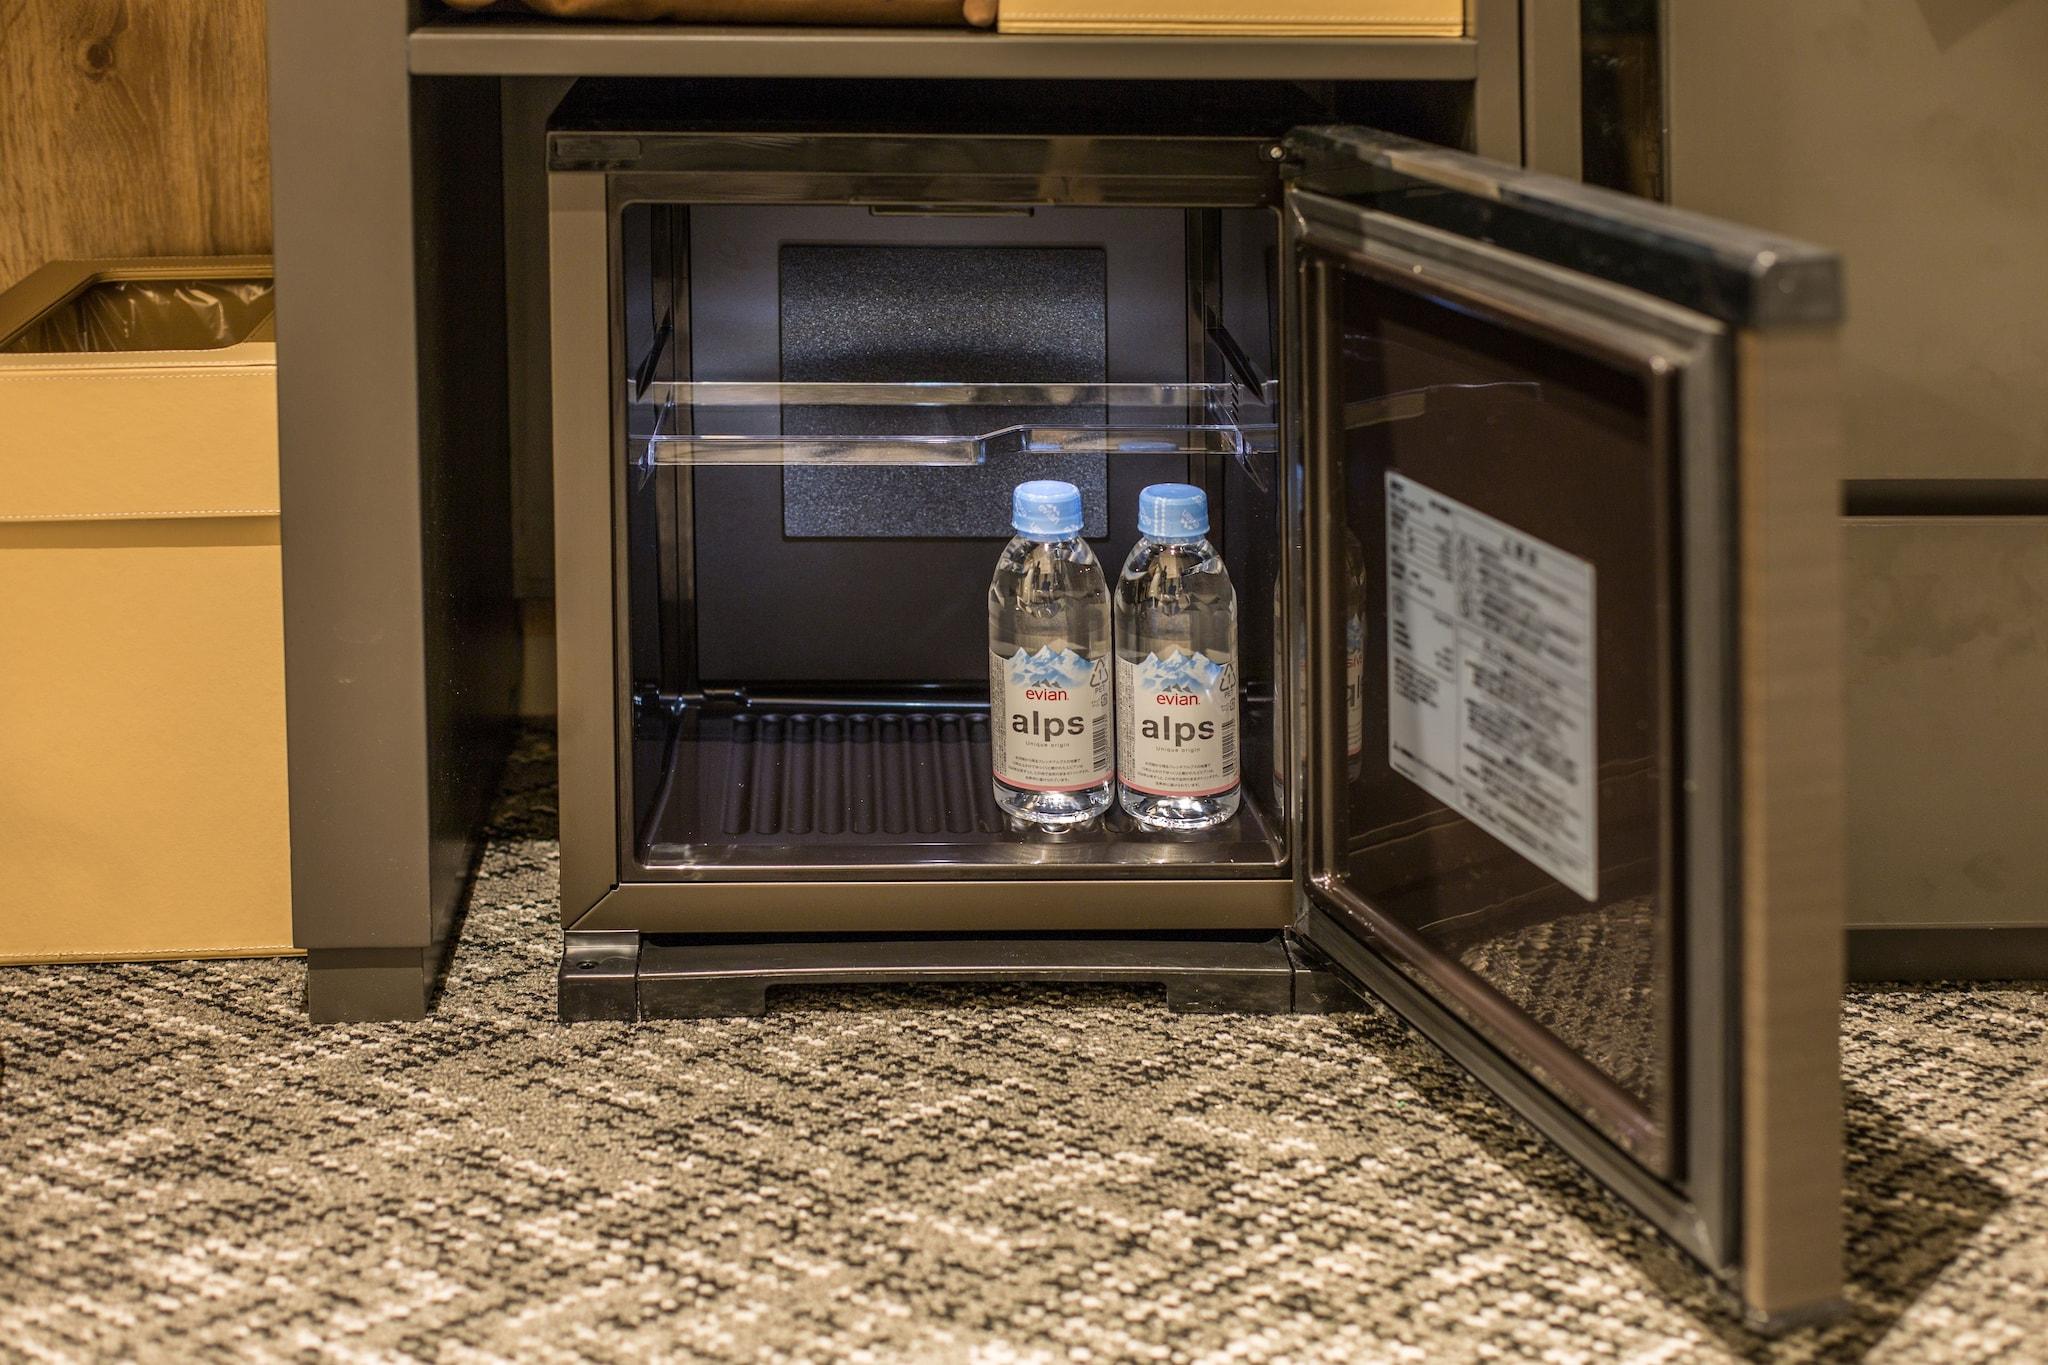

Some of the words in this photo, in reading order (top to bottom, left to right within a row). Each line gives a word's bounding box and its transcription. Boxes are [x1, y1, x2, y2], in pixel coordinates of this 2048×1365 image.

[1026, 689, 1067, 701] evian
[1156, 693, 1199, 705] evian
[1012, 710, 1084, 742] alps
[1142, 716, 1214, 747] alps
[1026, 740, 1047, 748] Unique
